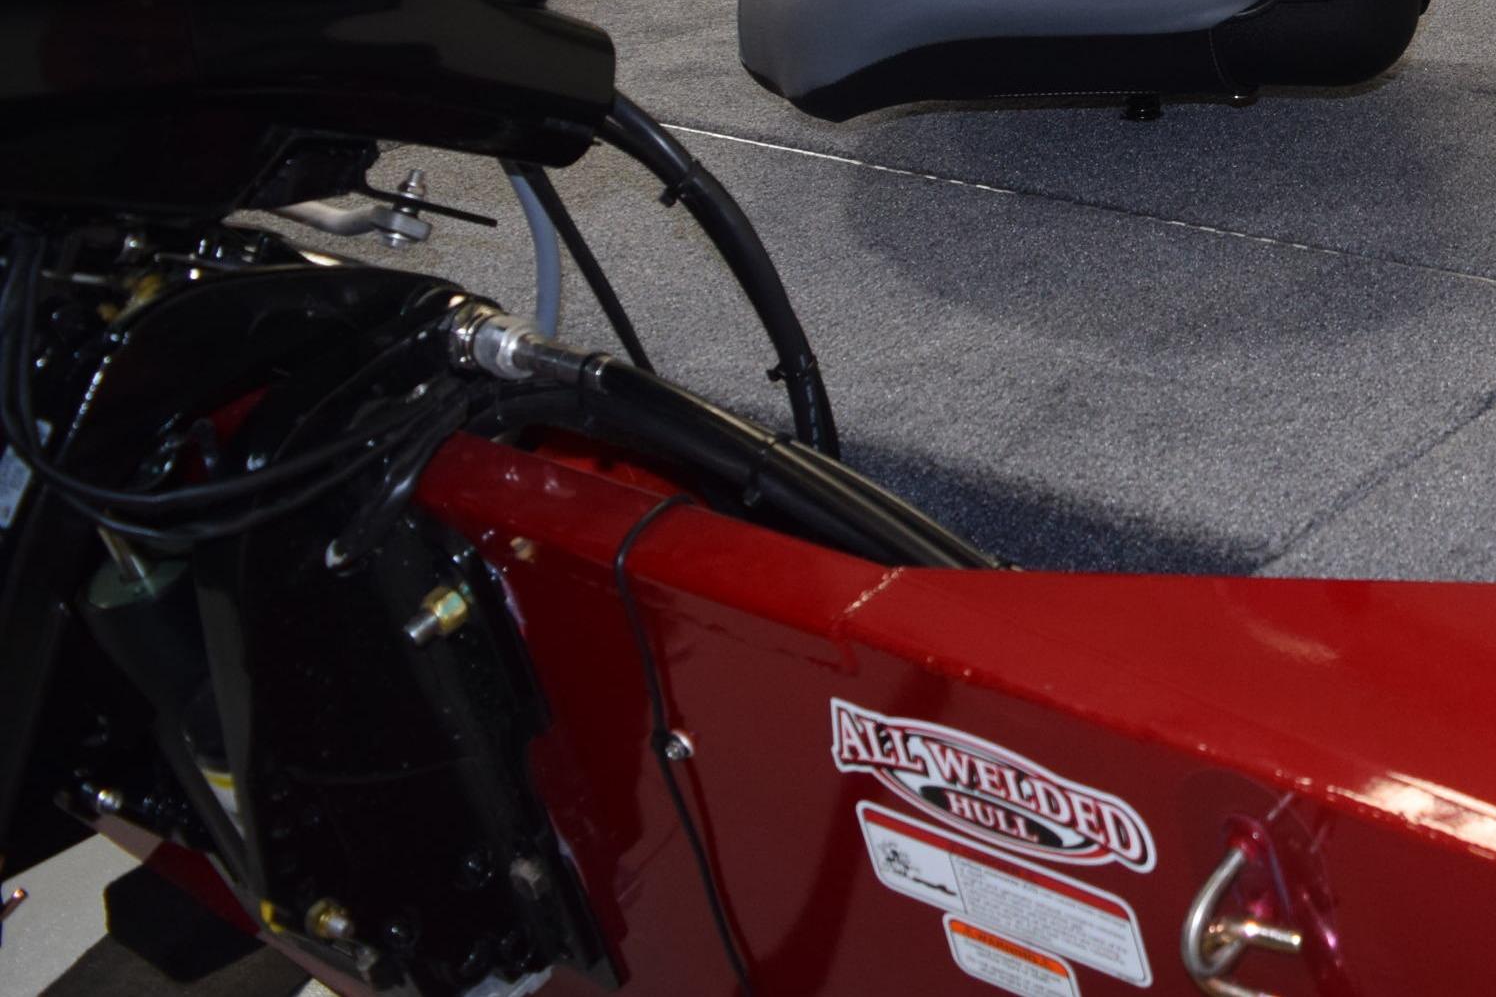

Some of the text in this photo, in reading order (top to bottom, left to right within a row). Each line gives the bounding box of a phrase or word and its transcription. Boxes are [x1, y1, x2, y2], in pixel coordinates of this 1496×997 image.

[840, 709, 1144, 862] ALL WELDED
[945, 790, 1040, 844] HULL
